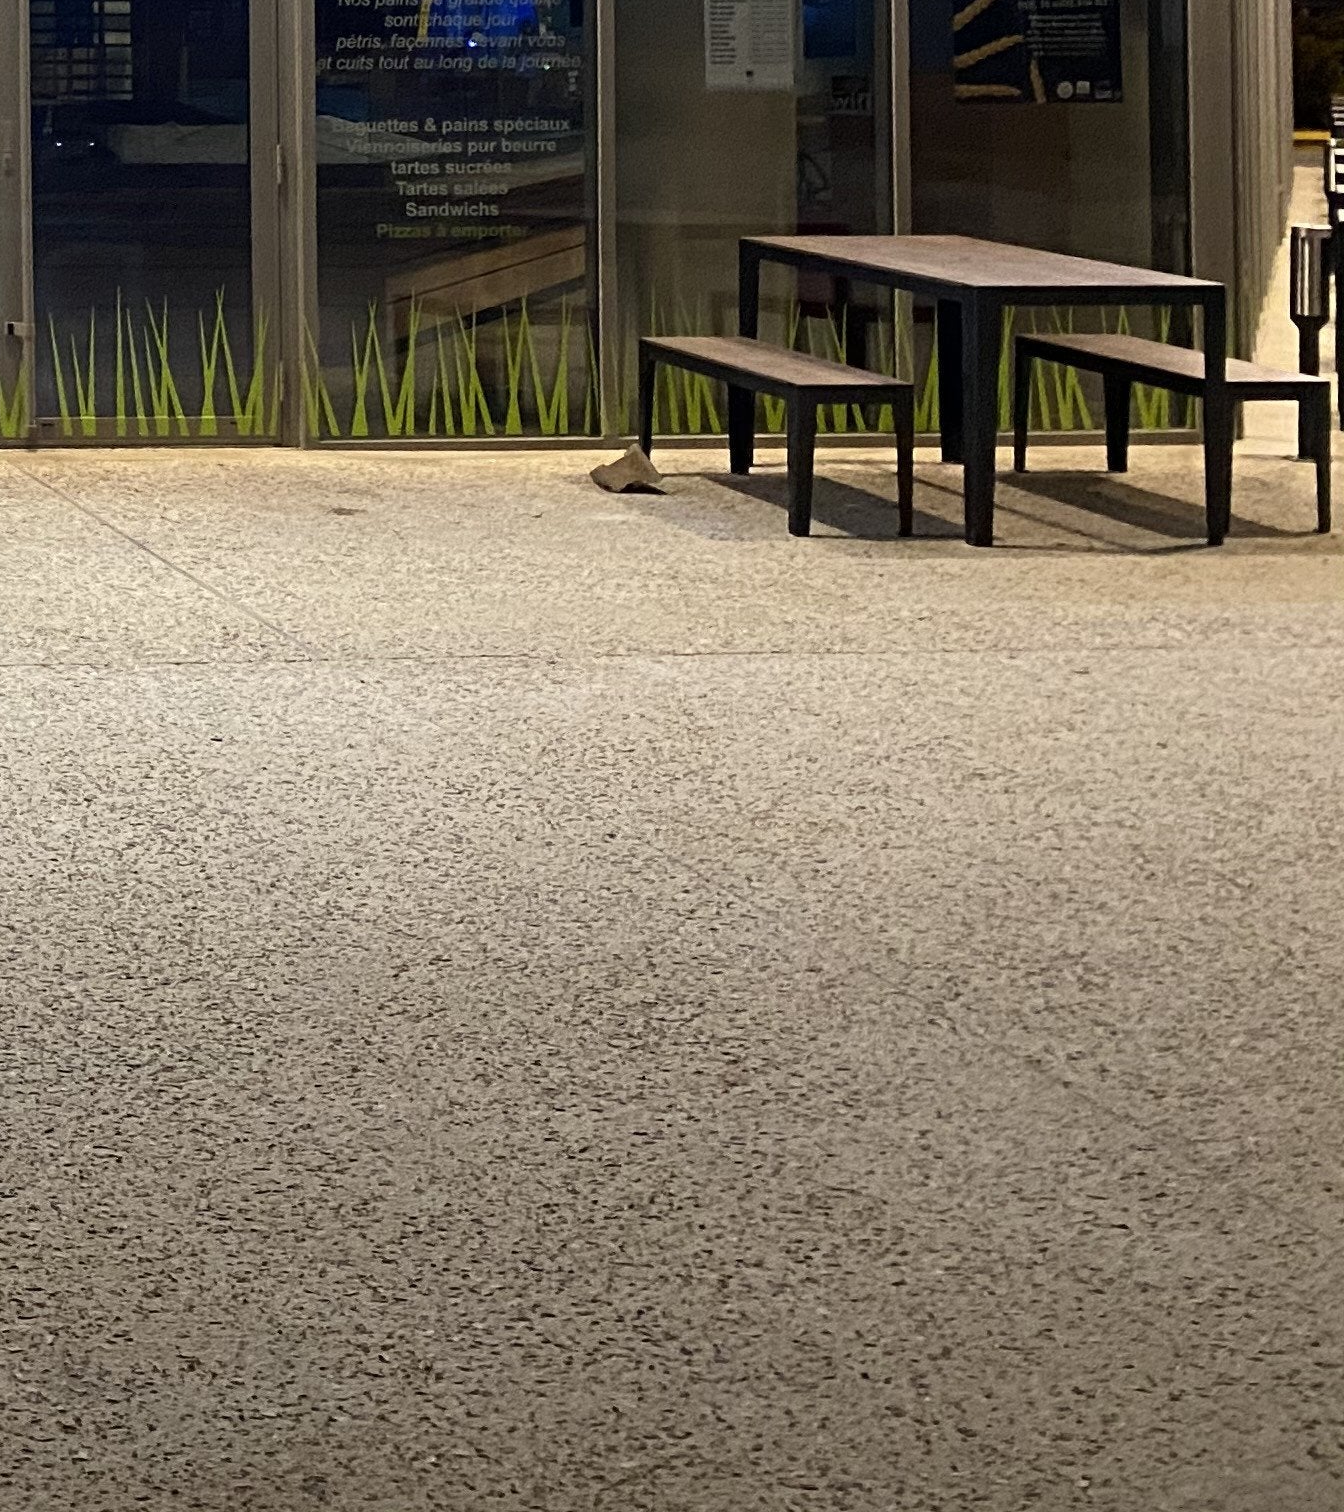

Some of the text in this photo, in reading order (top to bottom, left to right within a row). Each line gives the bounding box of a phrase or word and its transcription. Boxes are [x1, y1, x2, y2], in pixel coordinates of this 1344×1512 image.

[384, 14, 419, 27] sont
[484, 15, 518, 30] jour
[469, 34, 523, 47] evant
[527, 36, 566, 48] vous
[336, 55, 374, 70] cuits
[379, 55, 410, 70] tout
[413, 58, 434, 70] au
[438, 55, 472, 72] long
[478, 55, 497, 69] de
[503, 55, 516, 69] la
[424, 117, 436, 132] &
[442, 118, 489, 134] pains
[493, 117, 570, 135] spéciaux
[346, 138, 557, 156] Viennoiseries pur beurre
[391, 161, 440, 174] tartes
[396, 181, 448, 195] Tartes
[406, 201, 500, 217] Sandwichs
[376, 223, 432, 238] Pizzas
[436, 222, 448, 238] à
